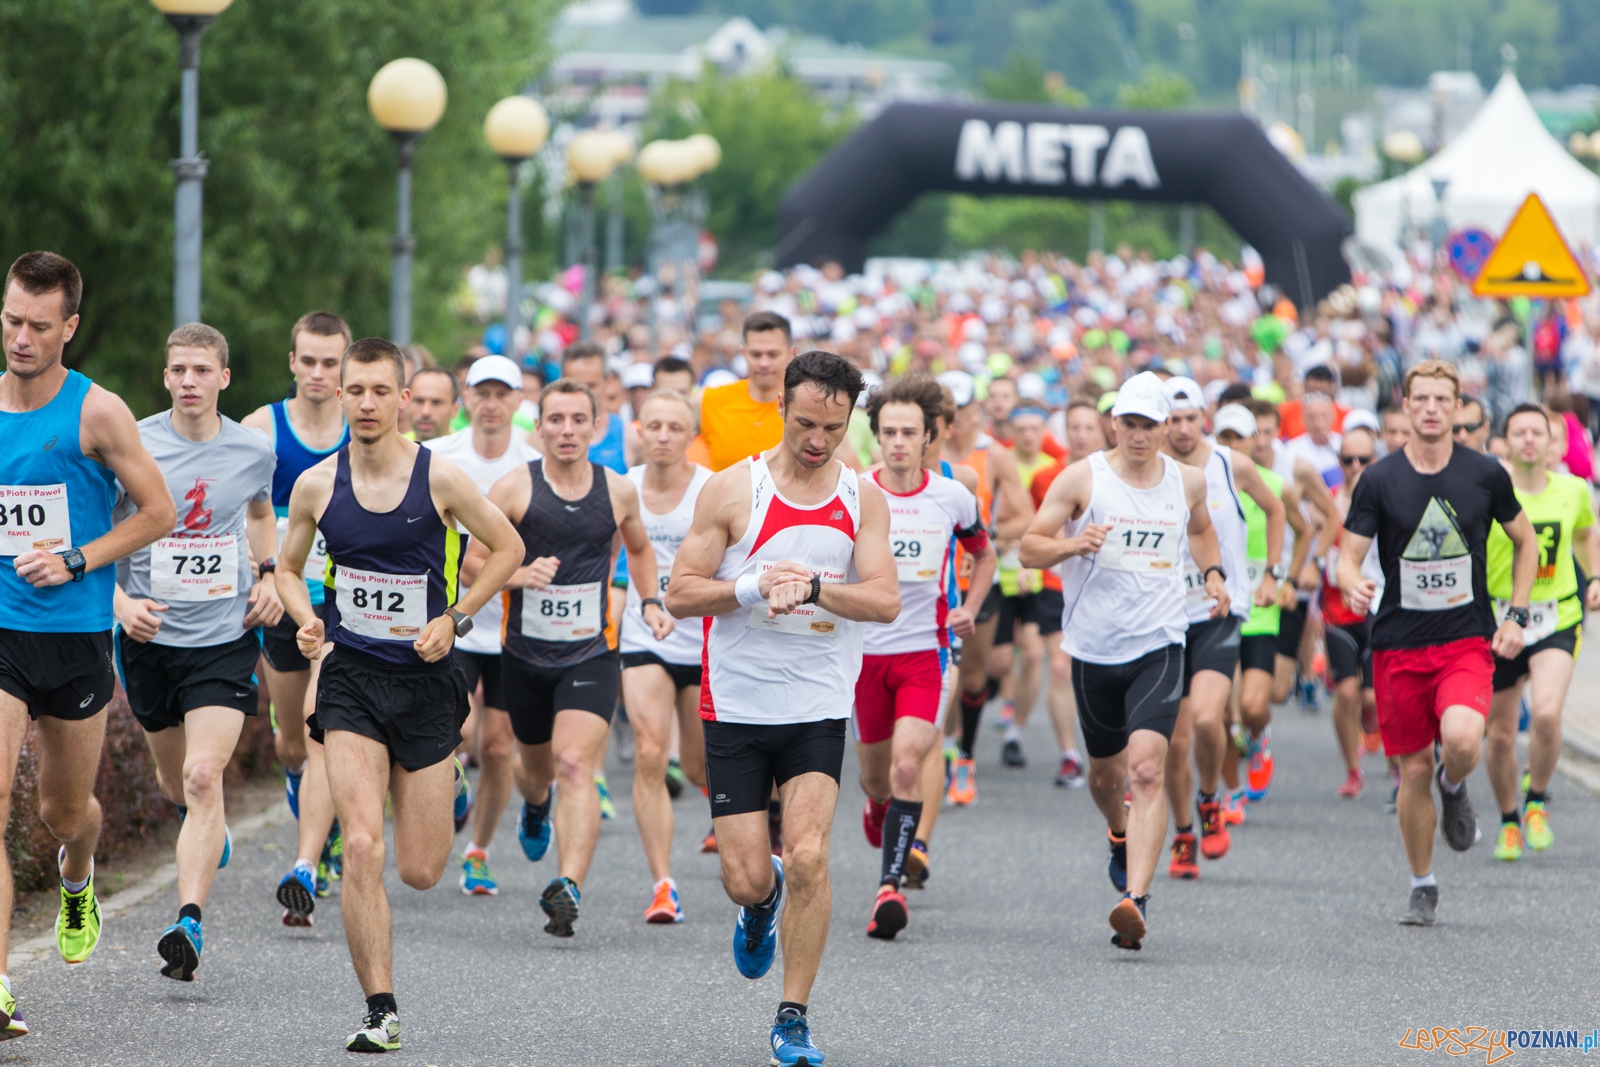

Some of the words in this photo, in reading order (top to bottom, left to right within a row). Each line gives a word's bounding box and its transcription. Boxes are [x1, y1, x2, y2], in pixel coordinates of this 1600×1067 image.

[955, 118, 1161, 189] META
[6, 489, 27, 497] Piotr
[34, 488, 61, 497] Paweł
[168, 541, 187, 550] Bieg
[1121, 529, 1165, 549] 177
[893, 540, 922, 558] 29
[172, 554, 222, 575] 732
[341, 569, 348, 577] IV
[349, 572, 367, 582] Bieg
[368, 575, 389, 584] Piotr
[823, 571, 845, 579] Paweł
[1416, 571, 1457, 589] 355
[352, 587, 405, 613] 812
[540, 598, 582, 618] 851
[363, 612, 393, 622] SZYMON
